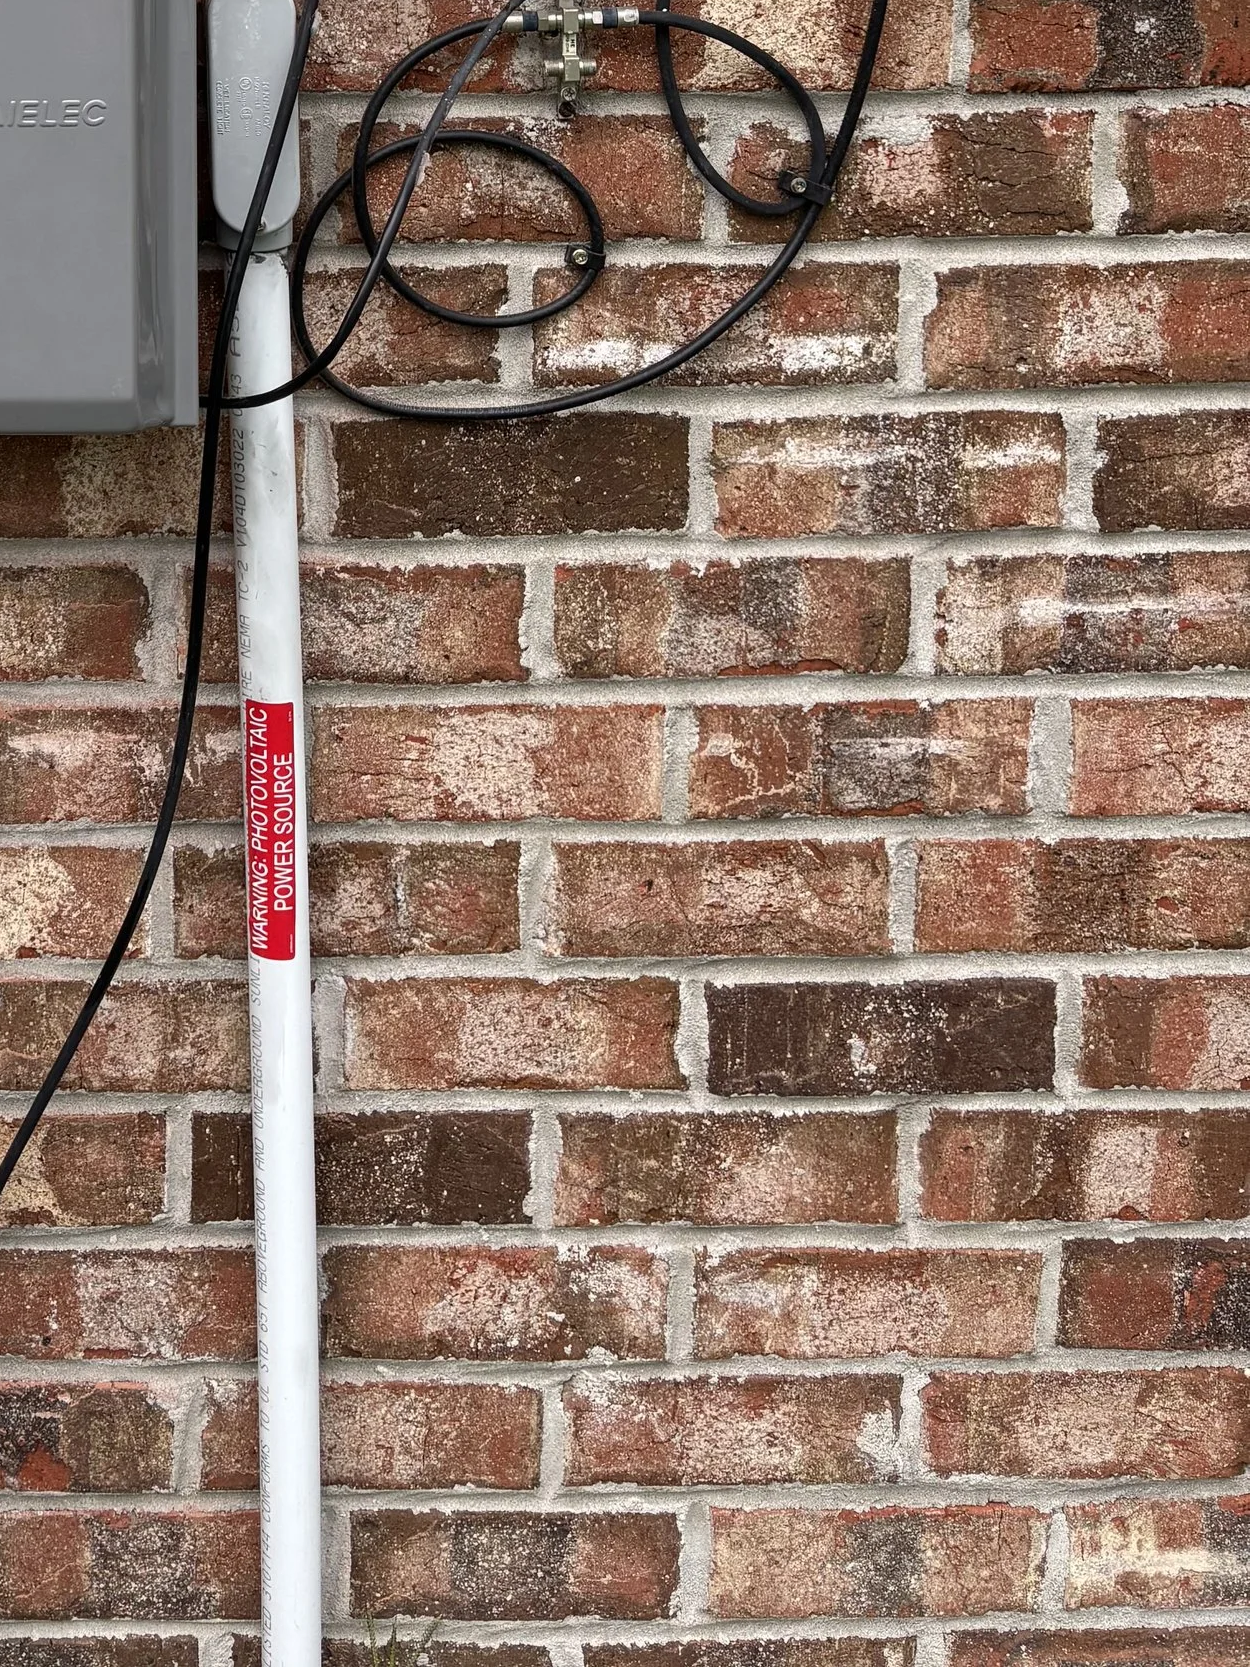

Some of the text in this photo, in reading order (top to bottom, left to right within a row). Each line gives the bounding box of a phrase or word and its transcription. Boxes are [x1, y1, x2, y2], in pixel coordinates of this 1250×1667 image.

[237, 560, 249, 602] TC-2
[239, 615, 251, 659] NEMA
[249, 706, 269, 950] WARNING: PHOTOVOLTAIC
[273, 752, 293, 911] POWER SOURCE
[250, 1015, 264, 1130] UNDERGROUND
[253, 1137, 264, 1172] AND
[254, 1177, 268, 1294] ABOVEGROUND
[258, 1303, 268, 1333] 651
[258, 1340, 269, 1373] STD
[259, 1385, 269, 1404] UL
[260, 1410, 270, 1432] TO
[260, 1442, 271, 1523] CONFORMS
[261, 1532, 272, 1602] 3107144
[262, 1606, 272, 1667] LISTED
